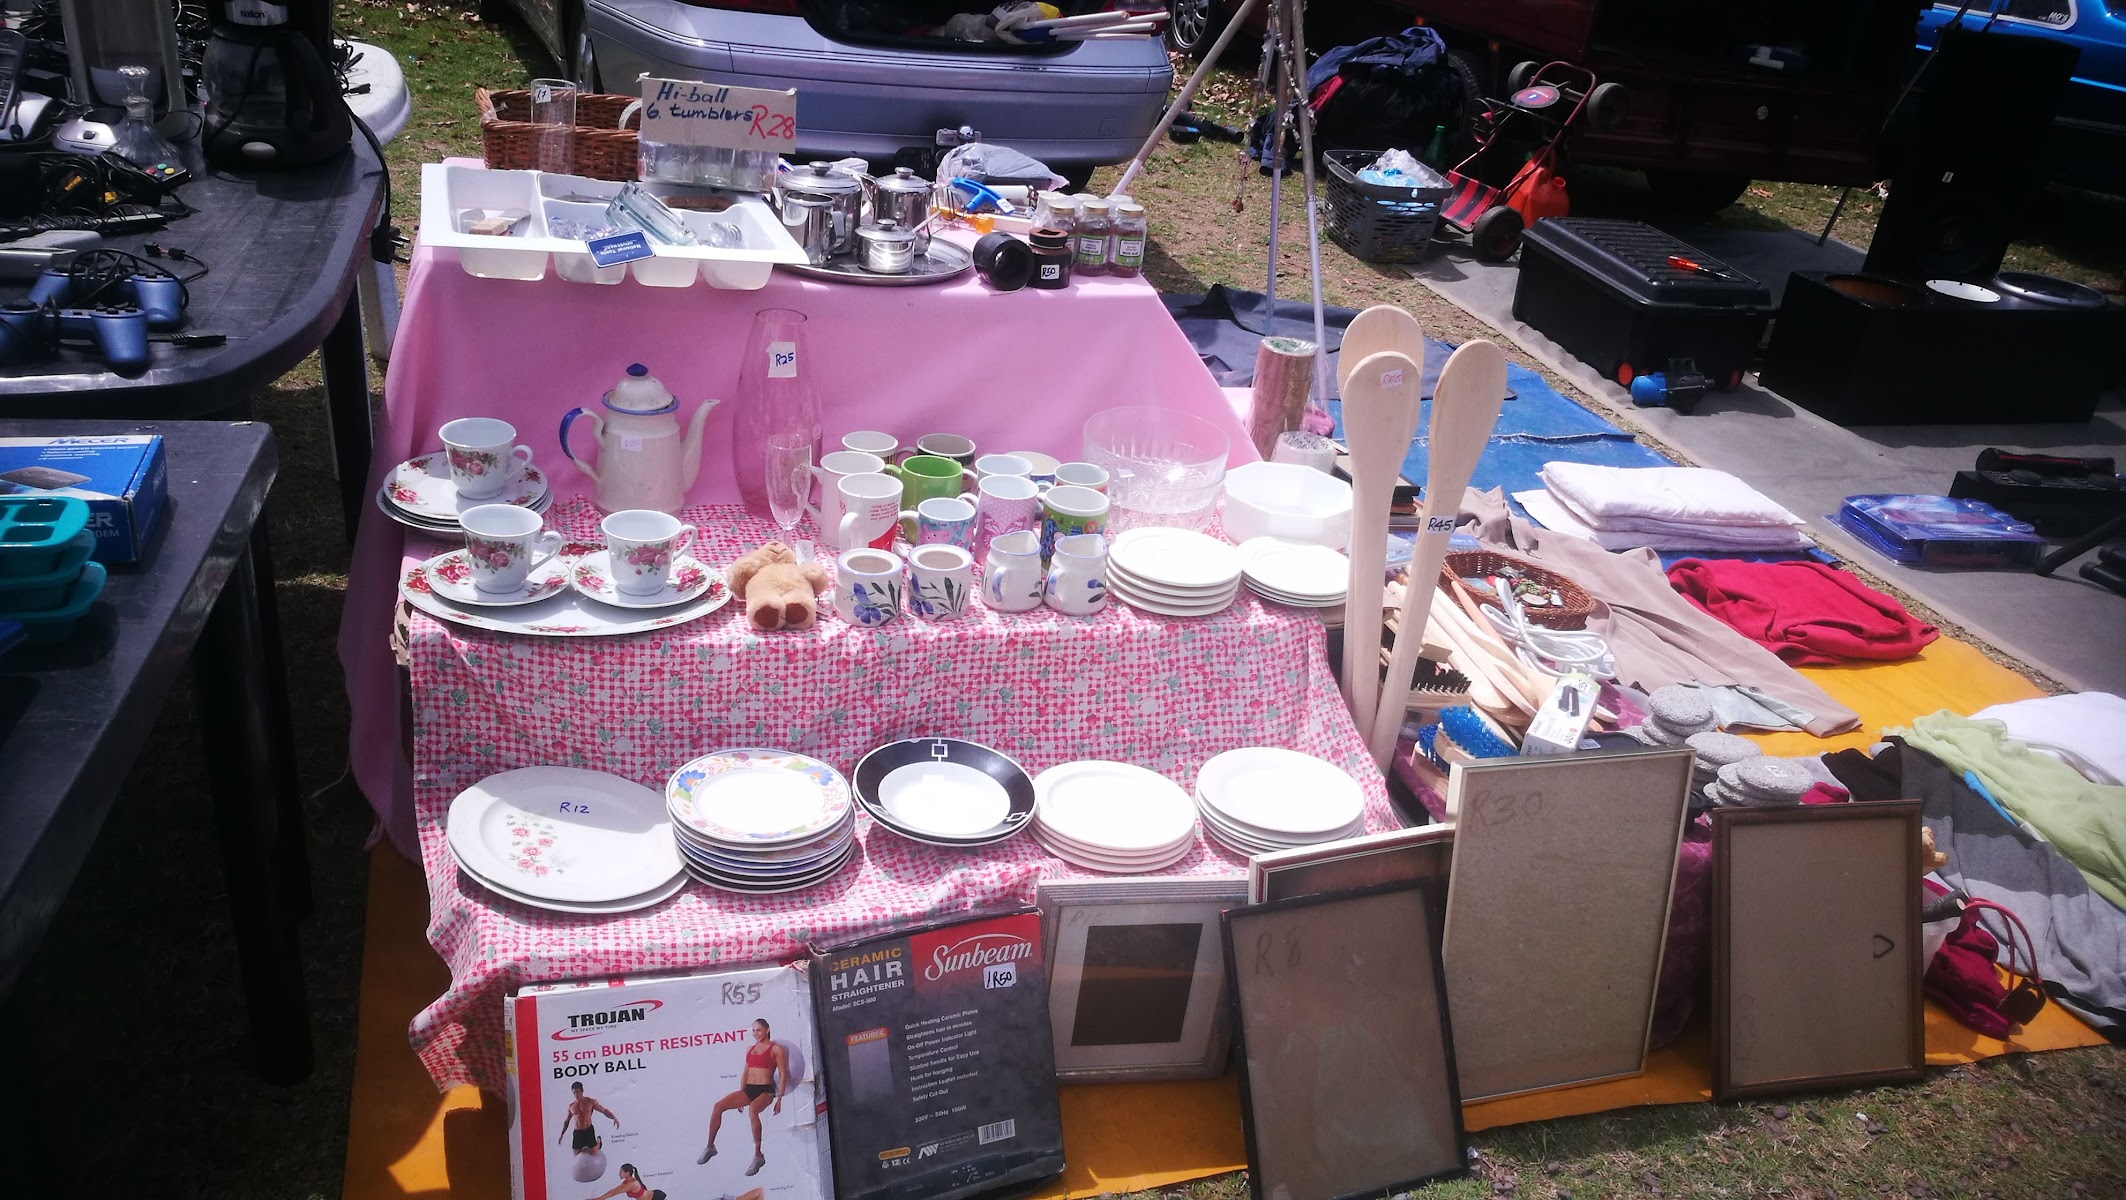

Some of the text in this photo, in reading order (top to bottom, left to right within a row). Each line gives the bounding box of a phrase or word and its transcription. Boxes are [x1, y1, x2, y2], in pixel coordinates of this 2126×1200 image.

[657, 82, 729, 104] Hi-ball
[669, 103, 754, 121] tumblers
[749, 104, 796, 140] R28
[775, 352, 795, 367] R25
[47, 437, 129, 445] MECER
[1427, 517, 1454, 532] R45
[559, 801, 590, 814] R12
[828, 947, 902, 972] CERAMIC
[924, 939, 1033, 981] Sunbeam
[830, 960, 903, 992] HAIR
[722, 981, 763, 1005] R55
[831, 979, 905, 1002] STRAIGHTENER
[832, 1002, 852, 1012] Model:
[567, 1007, 645, 1028] TROJAN
[904, 1022, 920, 1030] Quick
[920, 1016, 941, 1026] Heating
[940, 1012, 962, 1022] Ceramic
[850, 1029, 885, 1042] FEATURES
[906, 1029, 935, 1041] Straightens
[952, 1020, 973, 1029] minutes
[924, 1038, 941, 1047] Power
[941, 1032, 964, 1042] Indicator
[964, 1029, 978, 1037] Light
[552, 1029, 747, 1063] 55 cm BURST RESISTANT
[908, 1044, 959, 1061] Temperature Control
[930, 1057, 948, 1066] handle
[956, 1052, 969, 1060] Easy
[553, 1058, 646, 1079] BODY BALL
[932, 1067, 953, 1076] hanging
[911, 1071, 978, 1092] Instruction Leaflet included
[912, 1088, 949, 1102] Safety Cut-Out
